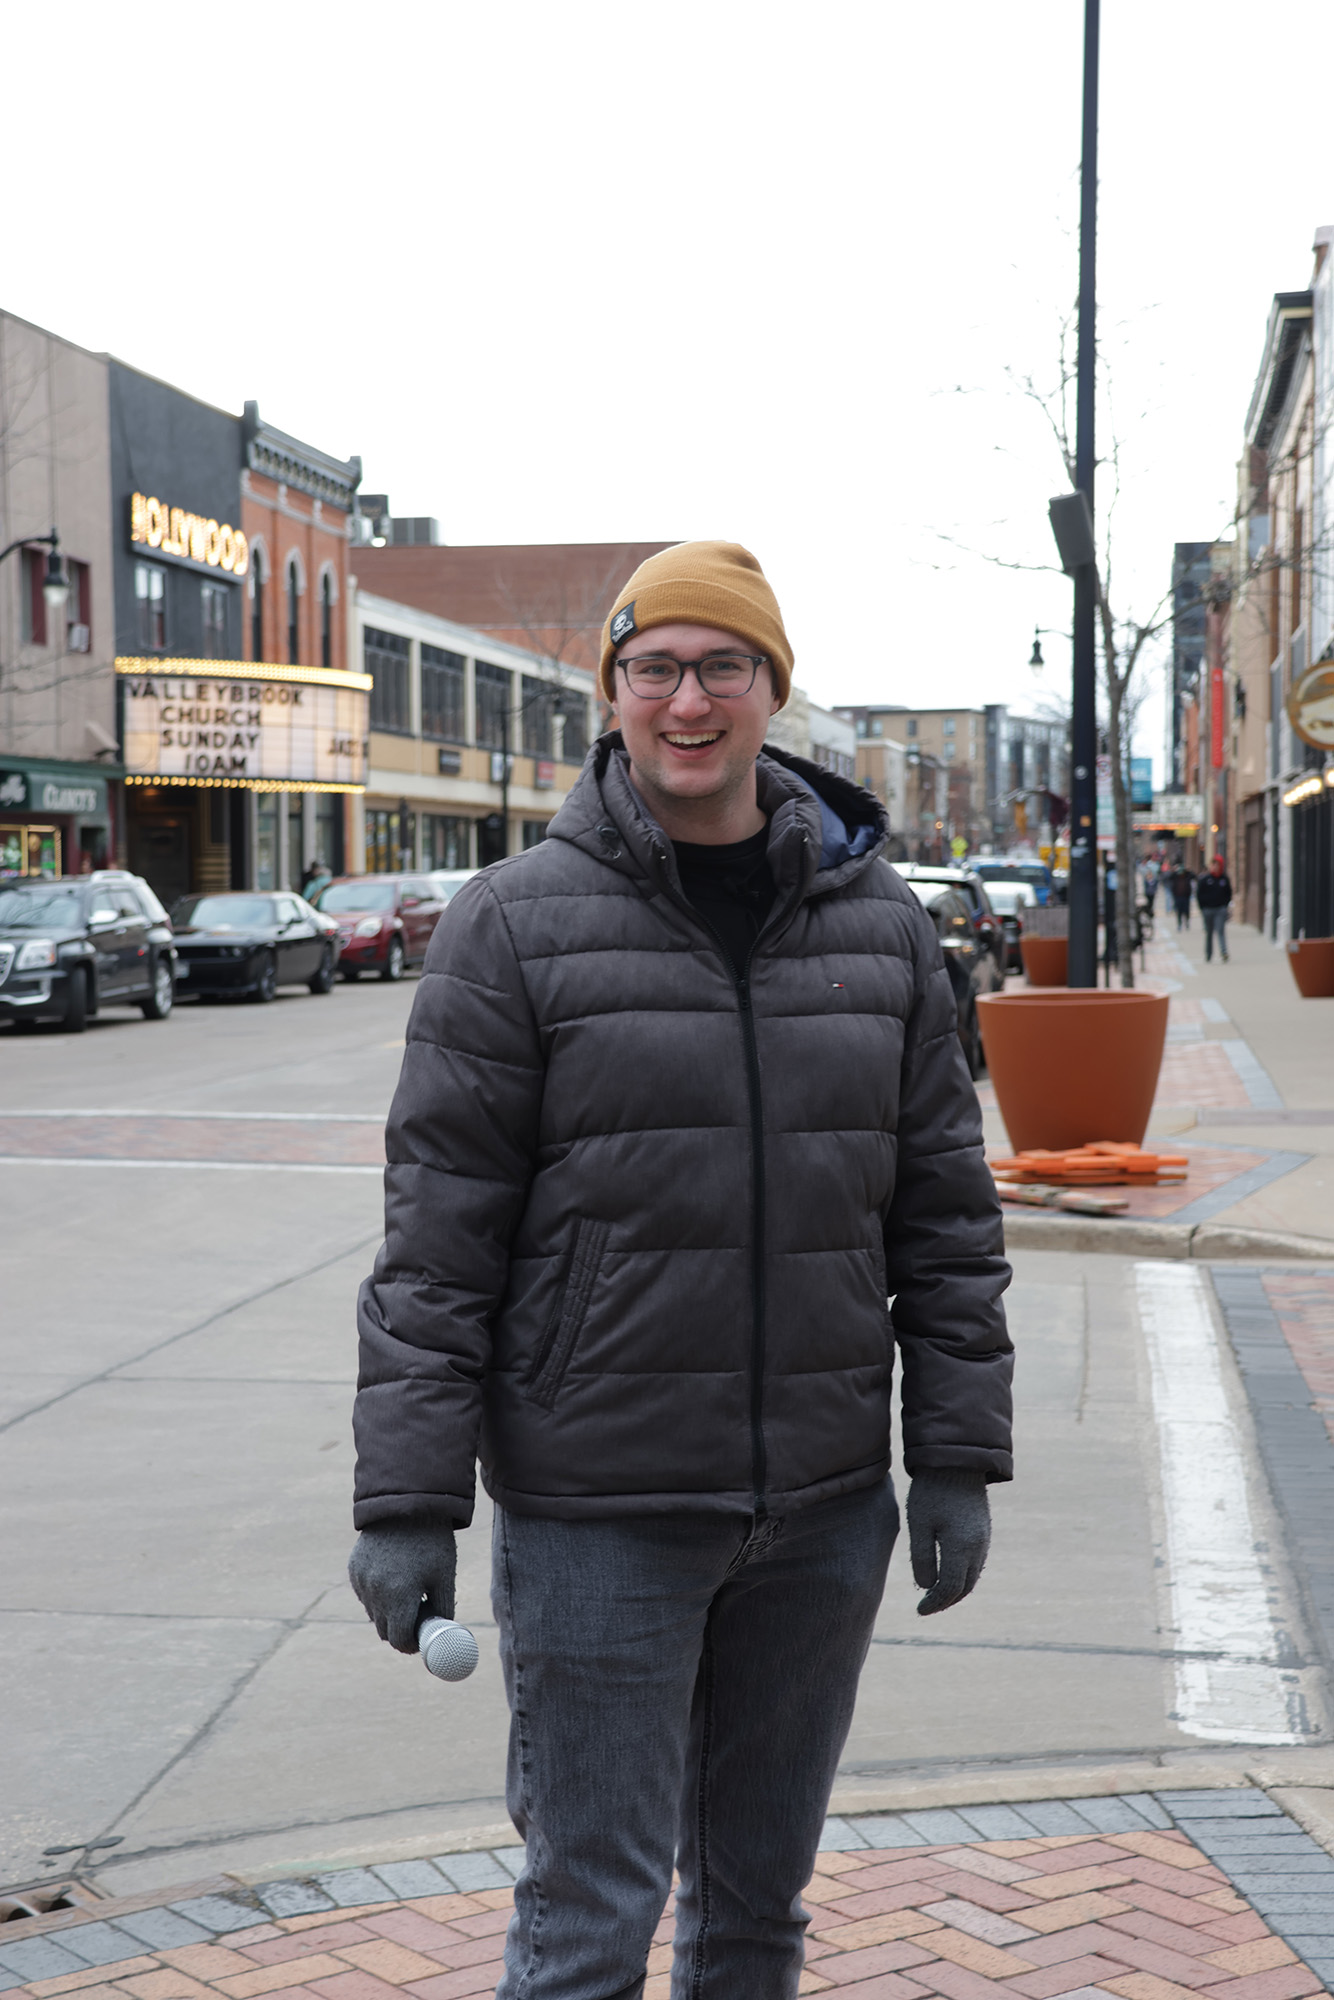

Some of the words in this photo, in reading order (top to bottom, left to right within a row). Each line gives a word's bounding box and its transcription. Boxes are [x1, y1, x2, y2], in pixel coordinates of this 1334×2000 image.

[131, 492, 249, 576] HOLLYWOOD
[128, 681, 303, 706] VALLEYBROOK
[160, 706, 261, 726] CHURCH
[161, 730, 260, 749] SUNDAY
[185, 754, 247, 772] 10AM
